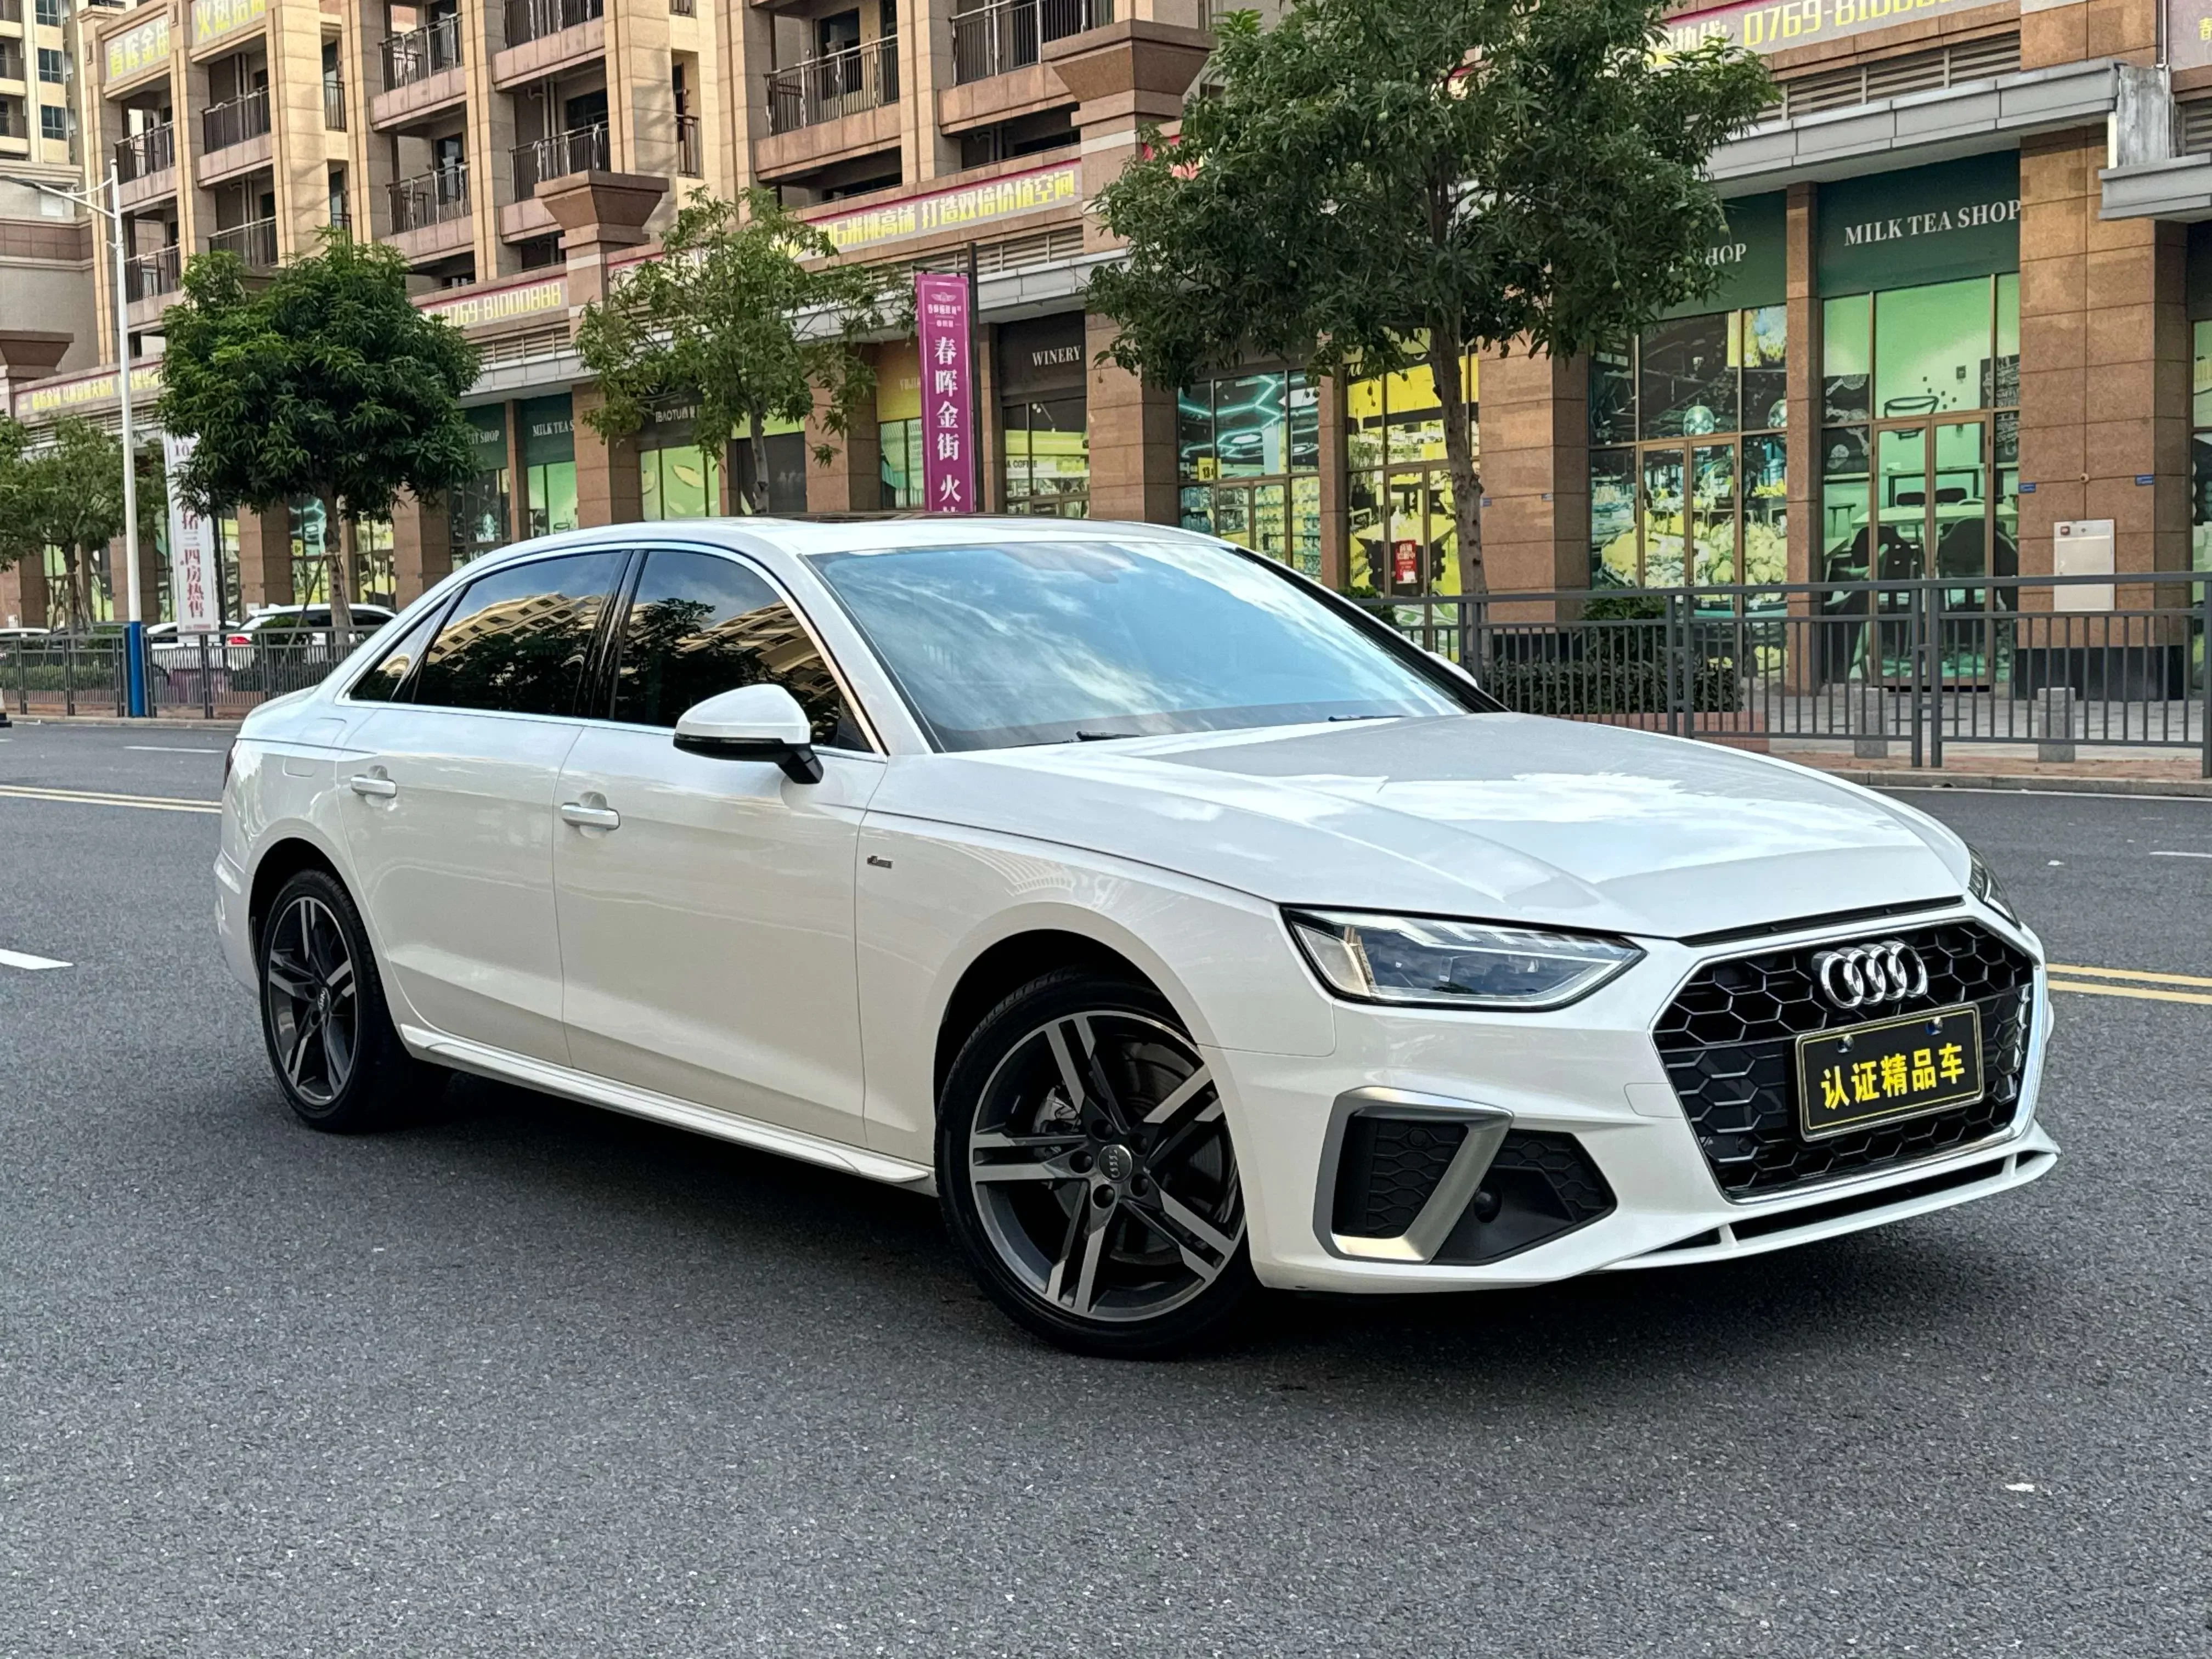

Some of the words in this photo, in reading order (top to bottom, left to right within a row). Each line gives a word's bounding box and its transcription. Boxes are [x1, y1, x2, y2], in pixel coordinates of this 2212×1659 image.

[921, 170, 1074, 229] 打造双倍价值空间
[1844, 218, 1903, 246] MILK
[1907, 210, 1953, 236] TEA
[1957, 199, 2021, 228] SHOP
[1031, 345, 1081, 367] WINERY
[934, 336, 961, 461] 春晖金街
[532, 422, 553, 437] MILK
[553, 420, 569, 434] TEA
[1820, 1042, 1965, 1110] 认证精品车
